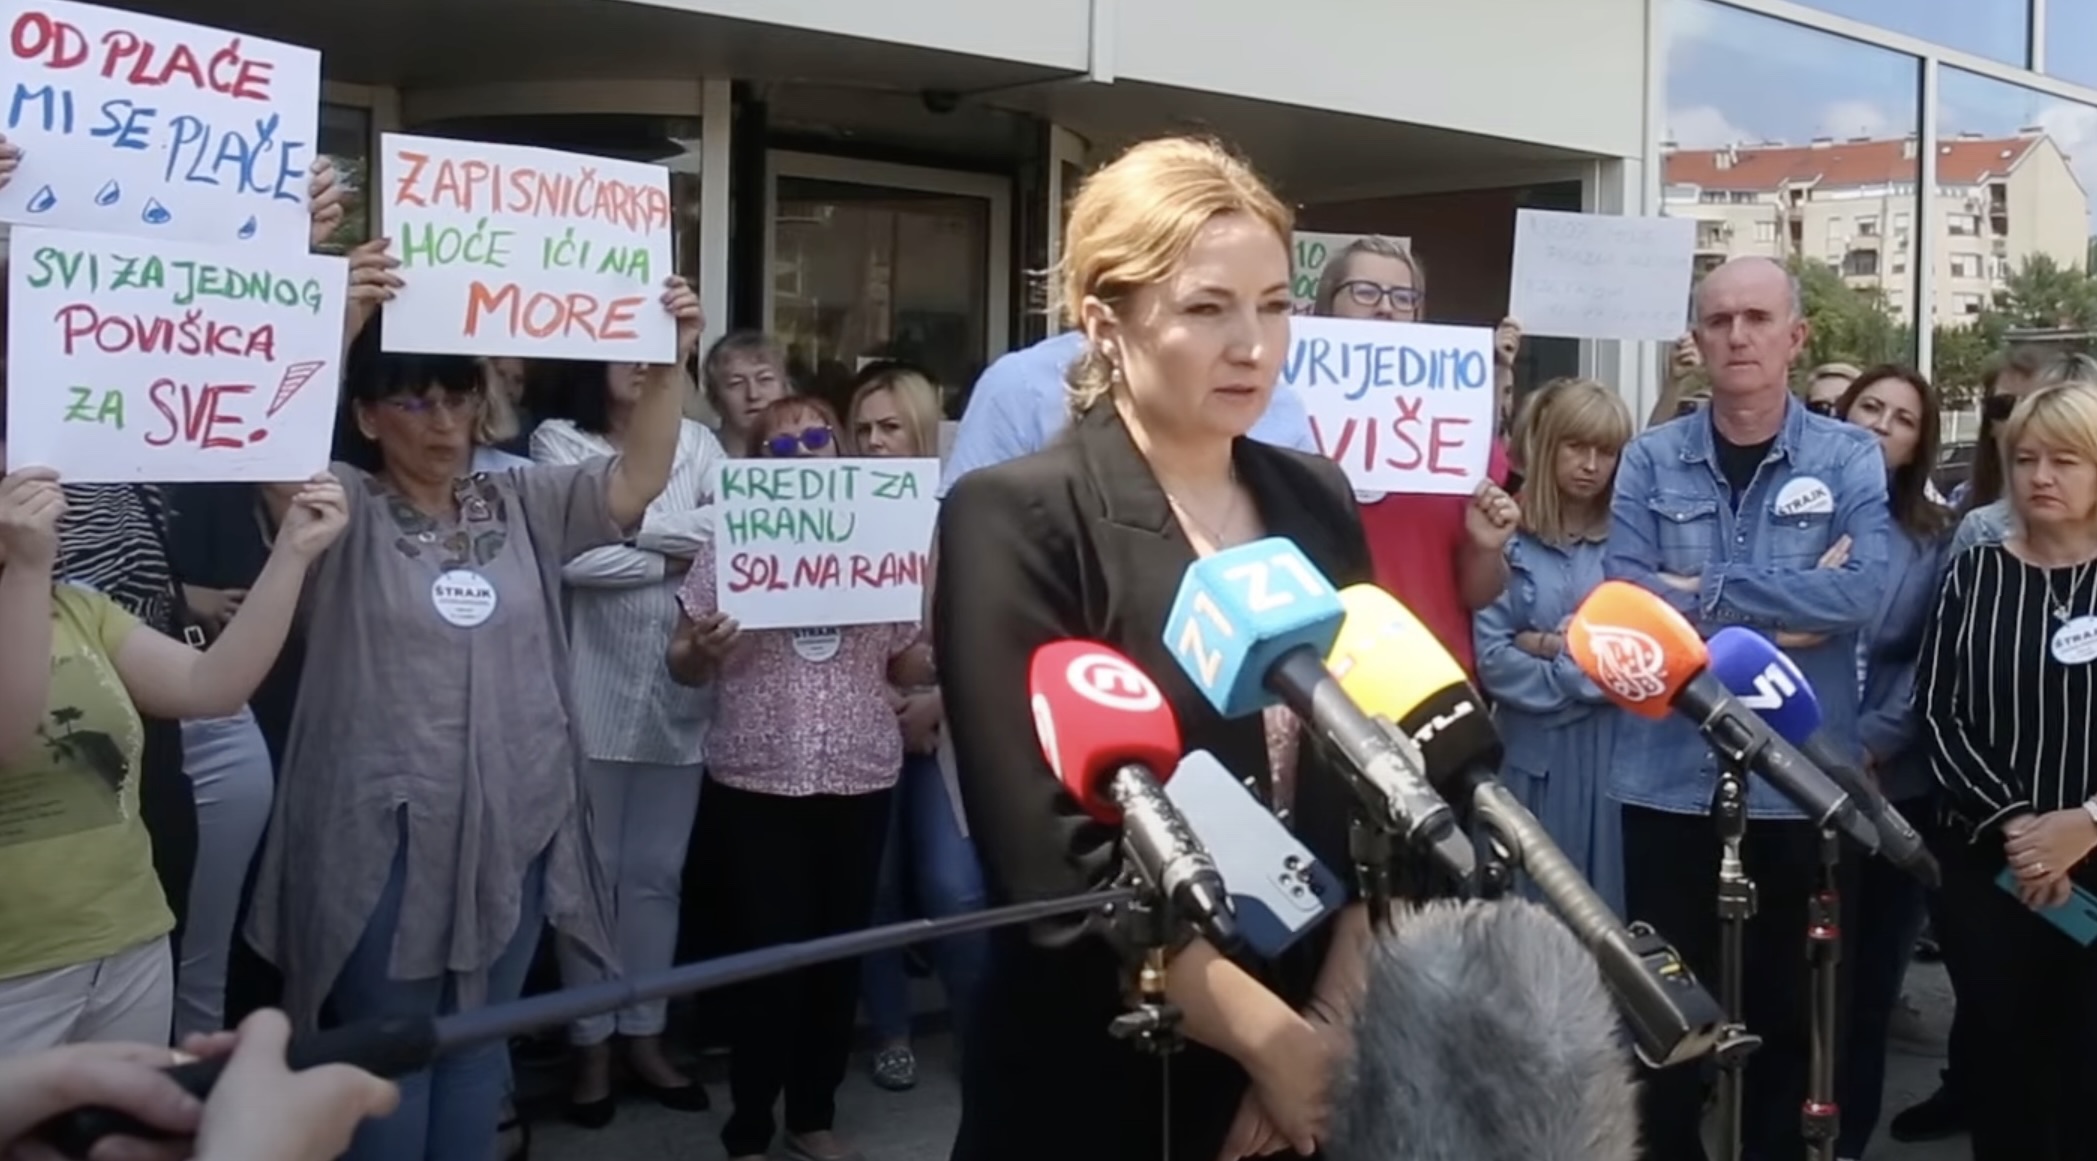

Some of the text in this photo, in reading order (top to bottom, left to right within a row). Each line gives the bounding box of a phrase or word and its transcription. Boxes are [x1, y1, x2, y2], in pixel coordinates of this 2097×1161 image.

[10, 11, 275, 101] OD PLAĆE
[8, 82, 306, 204] MI SE PLAČE
[394, 150, 672, 237] ZAPISNIČARKA
[27, 247, 323, 315] SVI ZA JEDNOG
[401, 216, 650, 285] HOĆE IĆI NA
[54, 303, 275, 362] POVIŠICA
[463, 280, 647, 341] MORE
[1283, 337, 1487, 401] VRIJEDIMO
[63, 360, 327, 450] ZA SVE!
[1308, 395, 1473, 477] VIŠE
[720, 465, 919, 501] KREDIT ZA
[725, 506, 856, 545] HRANU
[727, 552, 788, 592] SOL
[793, 553, 841, 590] NA
[1221, 552, 1326, 613] Z1
[1178, 588, 1235, 690] Z1
